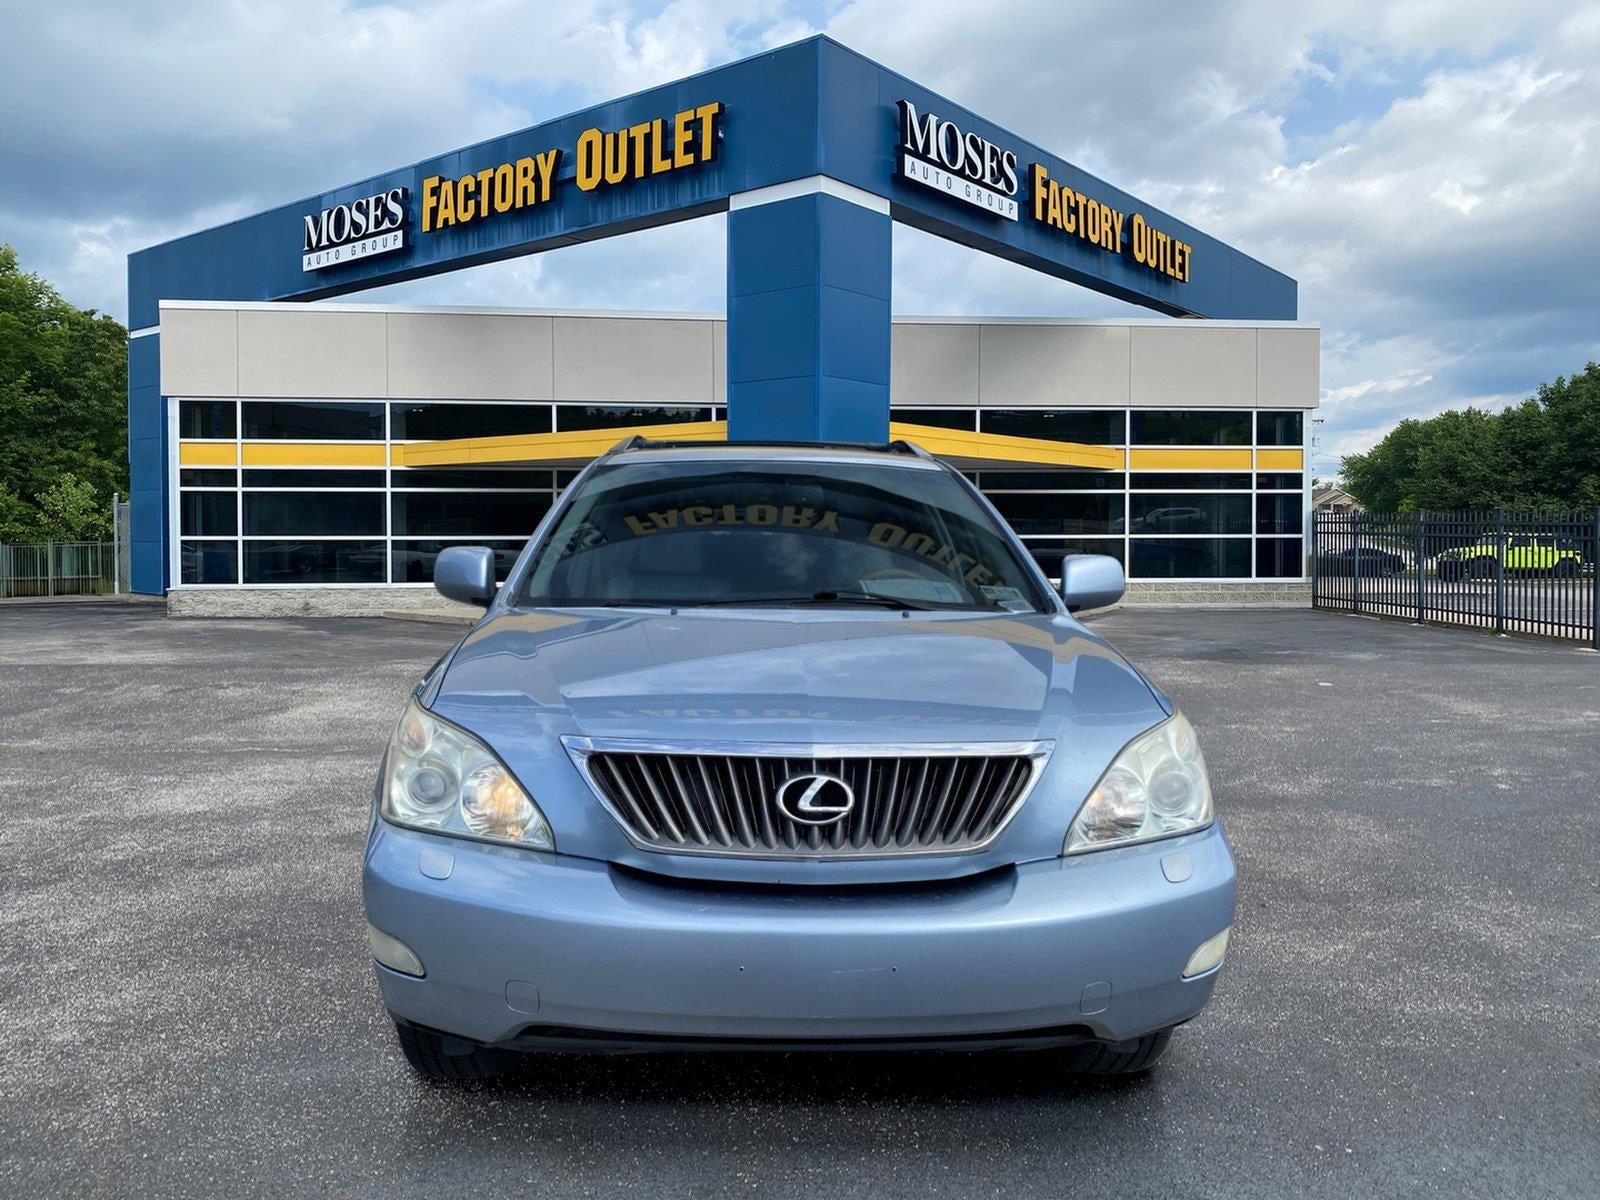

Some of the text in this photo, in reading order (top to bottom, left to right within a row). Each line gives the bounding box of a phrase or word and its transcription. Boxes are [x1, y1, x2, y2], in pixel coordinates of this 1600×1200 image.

[904, 100, 1018, 194] MOSES
[910, 162, 1014, 214] AUTO GROUP
[303, 188, 404, 250] MOSES
[307, 235, 399, 266] AUTO GROUP
